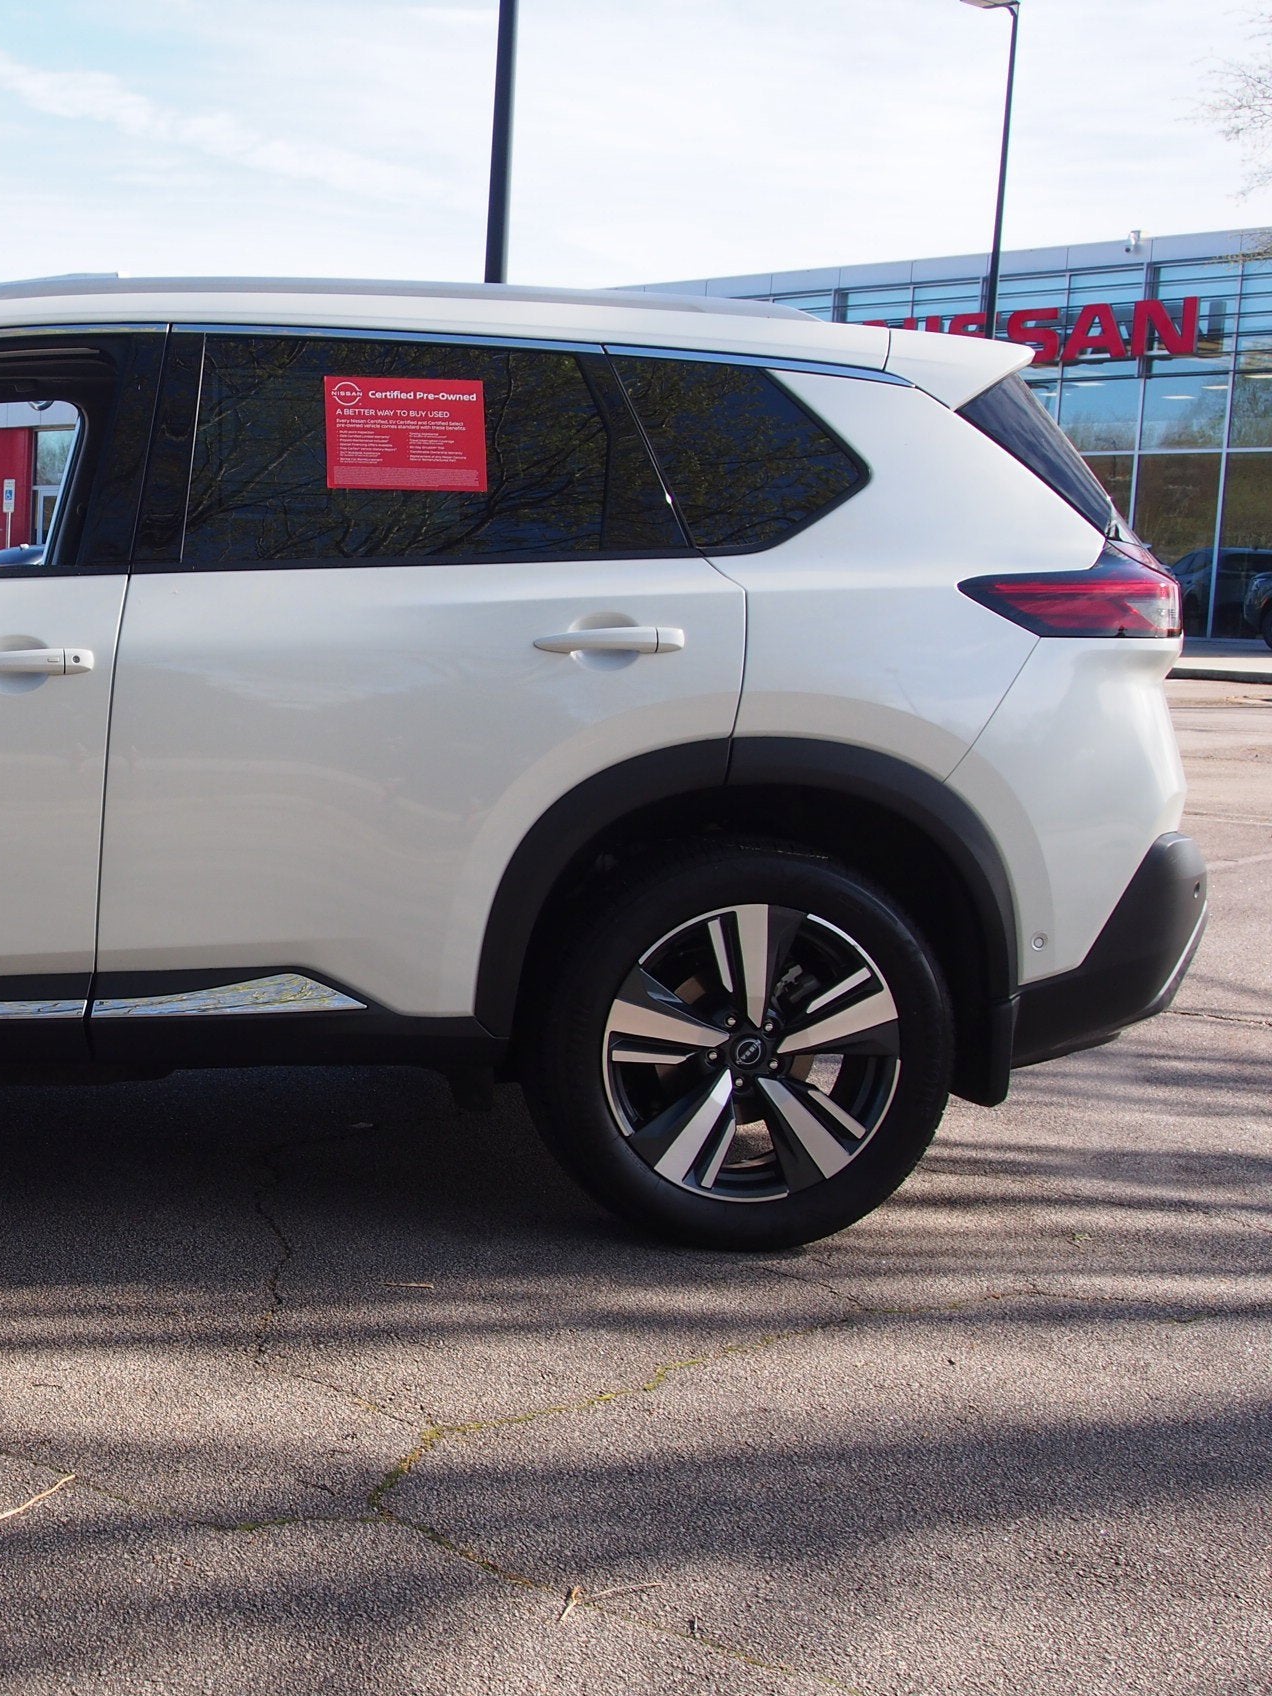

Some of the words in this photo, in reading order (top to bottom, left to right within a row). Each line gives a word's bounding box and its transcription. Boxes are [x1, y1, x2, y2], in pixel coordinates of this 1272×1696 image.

[863, 296, 1199, 364] SAN
[369, 390, 414, 400] Certified
[416, 391, 477, 402] Pre-Owned
[343, 408, 376, 416] BETTER
[395, 409, 408, 417] TO
[428, 410, 450, 418] USED
